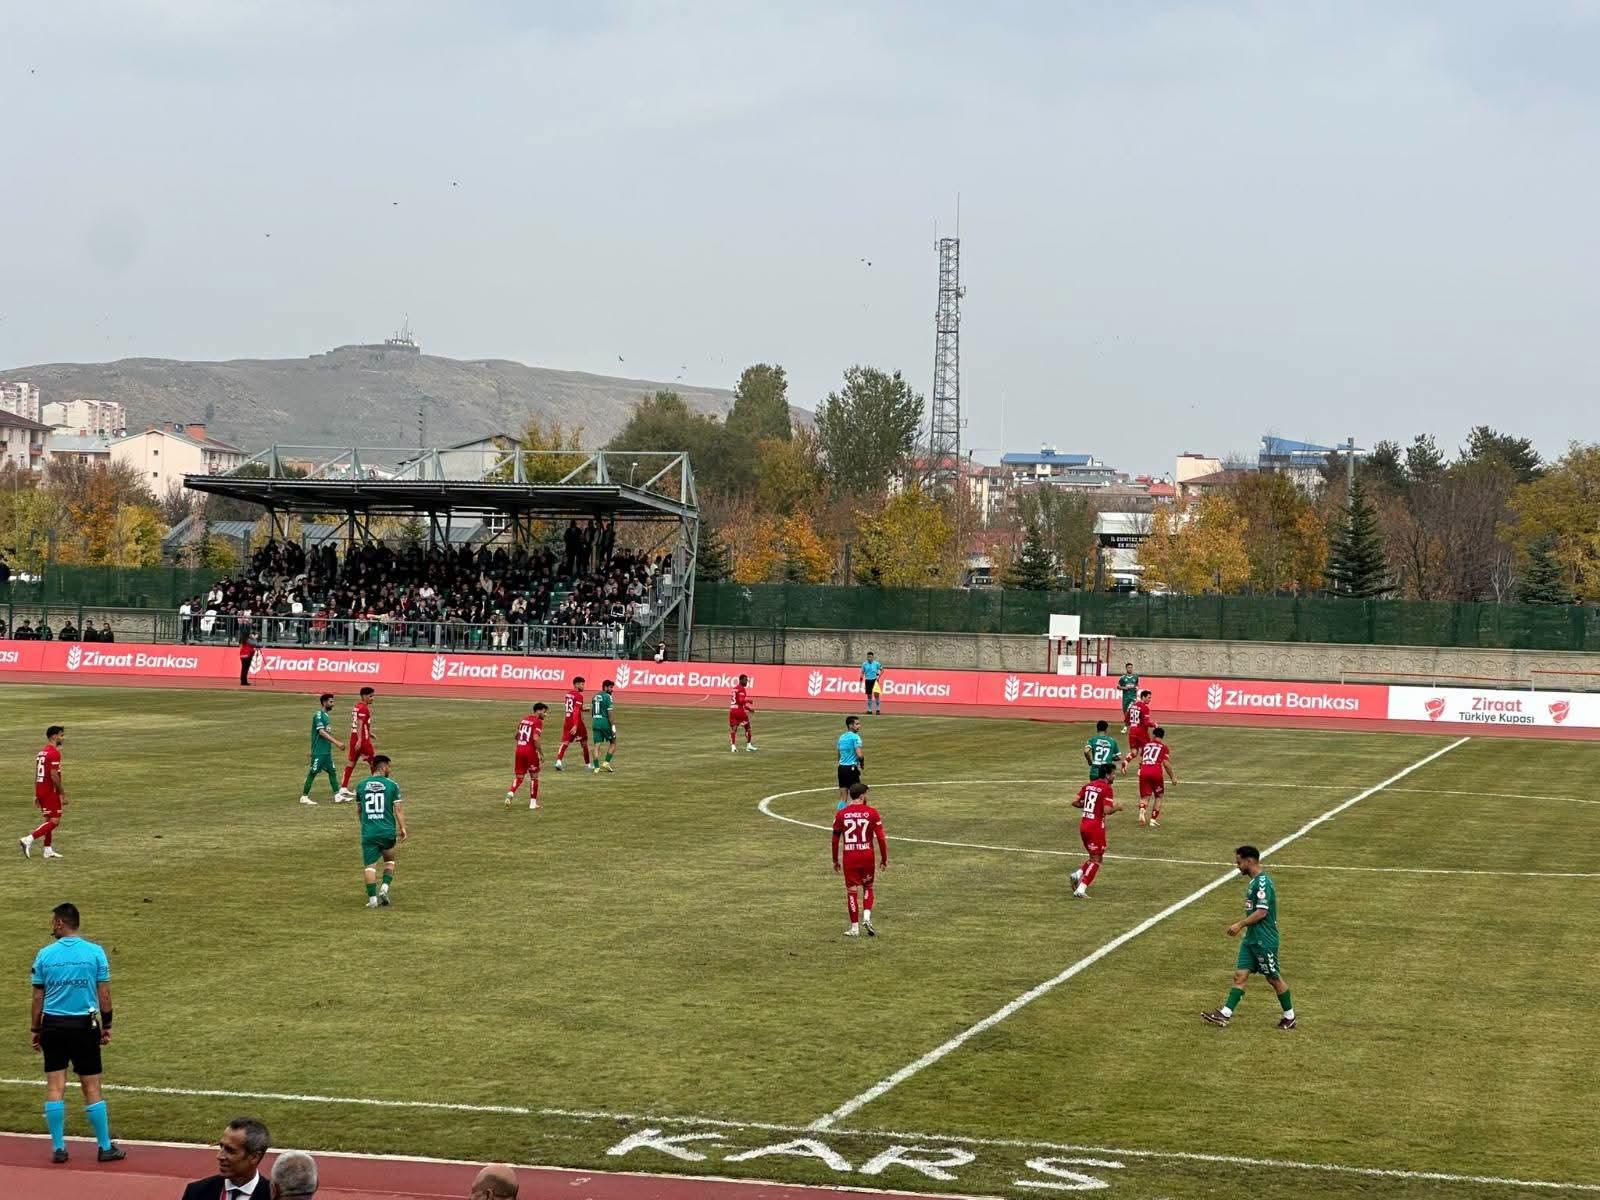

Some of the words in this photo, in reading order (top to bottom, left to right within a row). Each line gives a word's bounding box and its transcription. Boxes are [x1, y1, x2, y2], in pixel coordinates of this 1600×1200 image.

[83, 652, 133, 667] Ziraat
[135, 653, 198, 668] Bankası
[264, 656, 315, 671] Ziraat
[317, 658, 380, 673] Bankası
[447, 662, 498, 678] Ziraat
[501, 663, 565, 681] Bankası
[632, 669, 685, 686] Ziraat
[882, 679, 951, 696] Bankası
[1022, 681, 1077, 698] Ziraat
[1225, 690, 1283, 707] Ziraat
[1286, 692, 1360, 710] Bankası
[1472, 697, 1523, 712] Ziraat
[1459, 711, 1497, 724] Türkiye
[1499, 713, 1535, 725] Kupası
[1094, 746, 1110, 761] 27
[1143, 746, 1161, 762] 20
[365, 793, 385, 813] 20
[1083, 790, 1098, 813] 18
[844, 819, 870, 843] 27
[606, 1128, 1126, 1191] KARS
